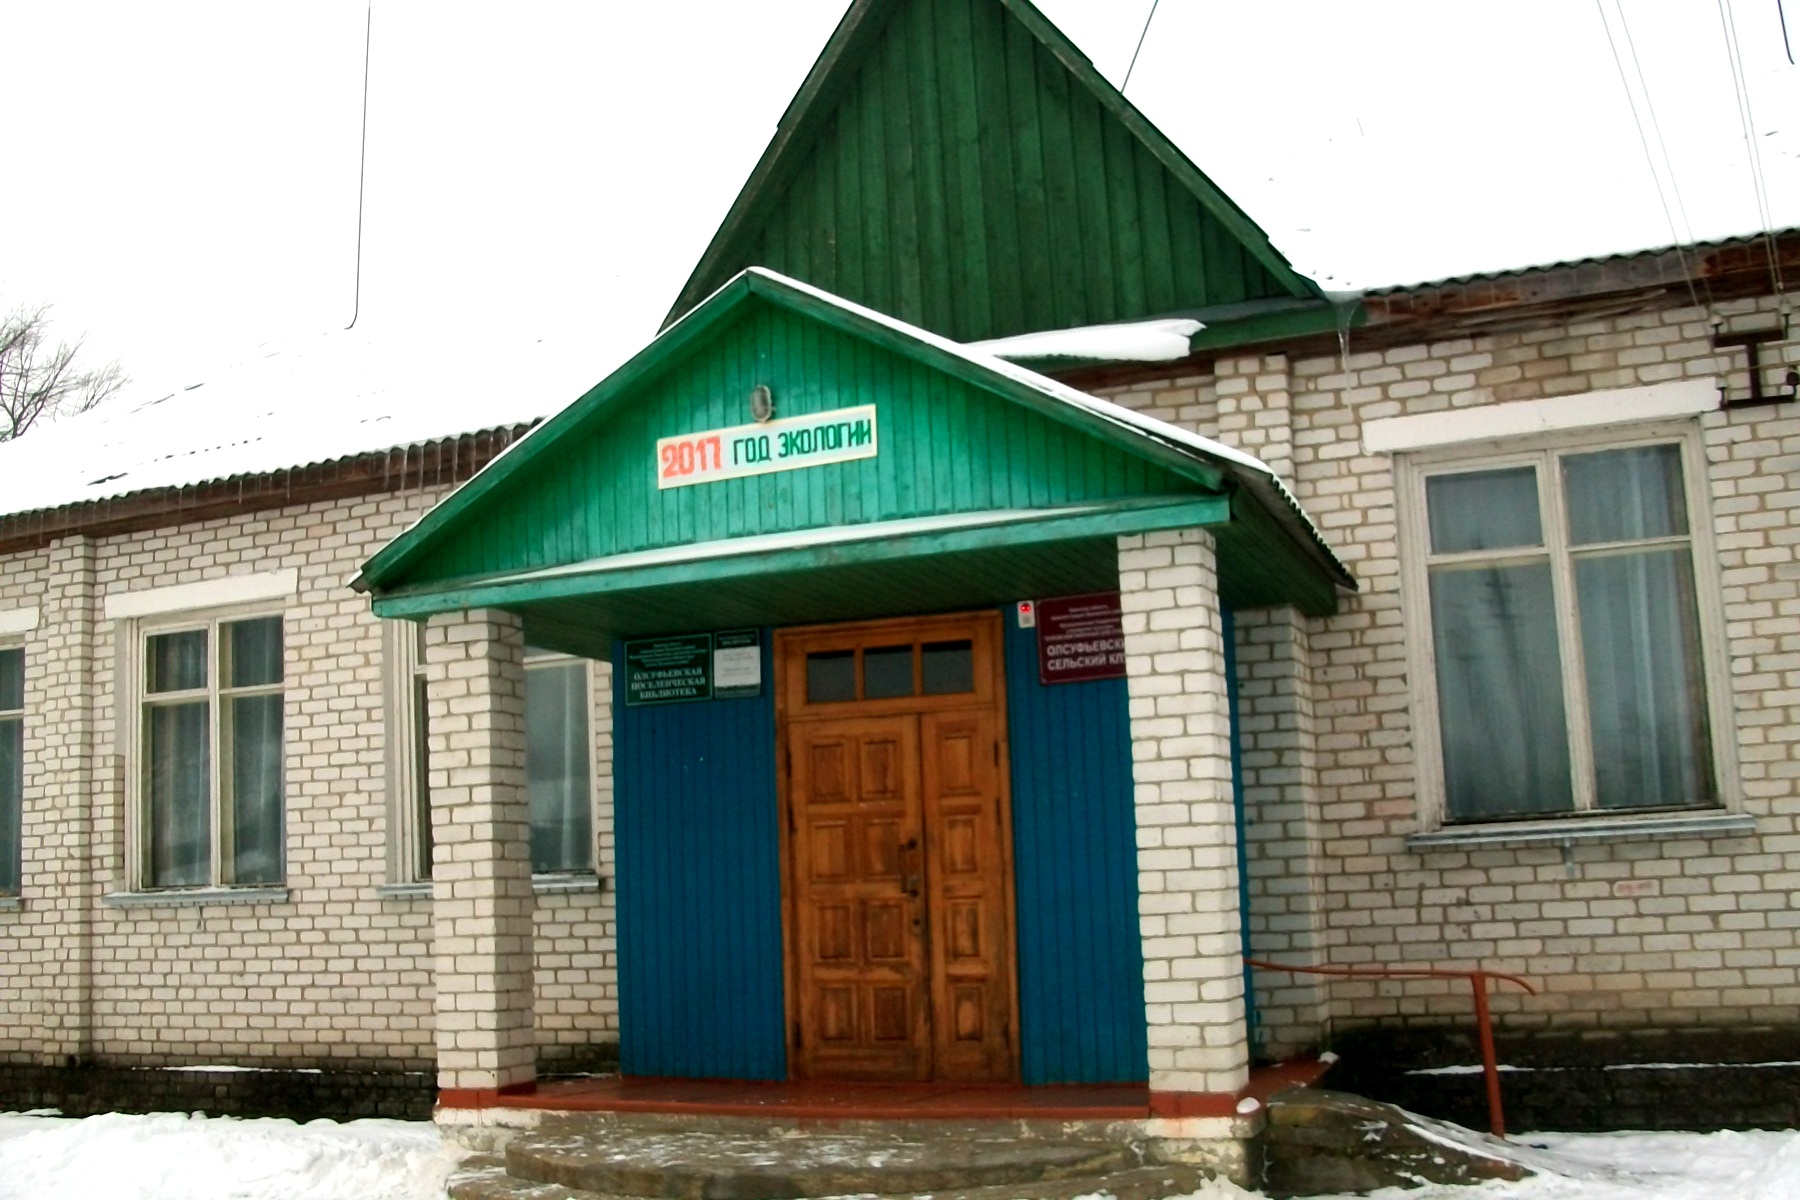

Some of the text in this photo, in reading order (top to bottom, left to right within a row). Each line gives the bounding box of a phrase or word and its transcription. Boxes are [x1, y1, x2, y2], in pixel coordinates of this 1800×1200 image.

[661, 418, 873, 478] 2017 ГОД ЭКОЛОГИИ
[1047, 652, 1107, 671] СЕЛЬСКИЙ
[633, 666, 703, 681] ОЛСУФЬЕВСКАЯ
[631, 676, 706, 691] ПОСЕЛЕНЧЕСКАЯ
[640, 687, 697, 700] БИБЛИОТЕКА
